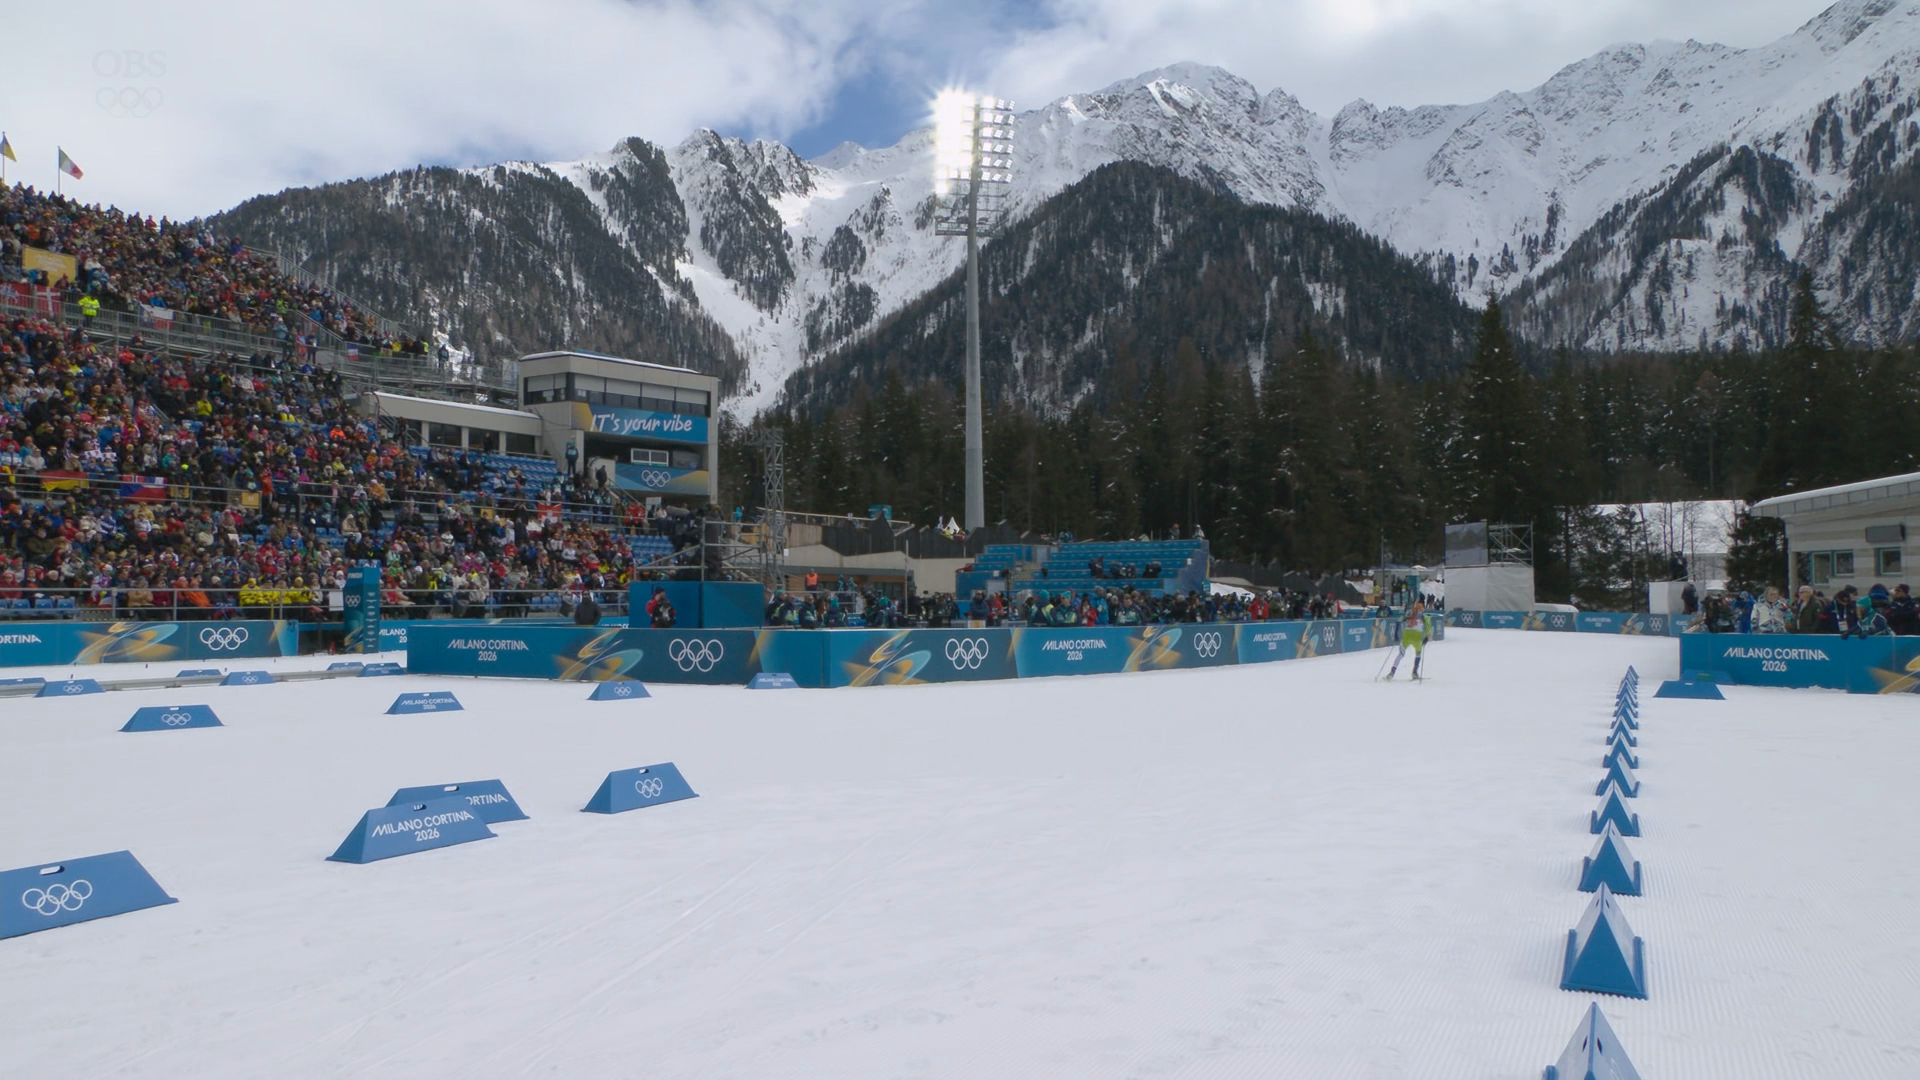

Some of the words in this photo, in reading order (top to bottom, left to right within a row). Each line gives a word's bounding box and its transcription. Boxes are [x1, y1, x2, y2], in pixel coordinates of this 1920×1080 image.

[589, 413, 620, 433] IT's
[620, 418, 661, 435] your
[663, 414, 693, 432] vibe
[447, 639, 487, 650] MILANO
[488, 639, 530, 651] CORTINA
[1042, 640, 1075, 651] MILANO
[1075, 639, 1107, 650] CORTINA
[478, 651, 498, 661] 2026
[1066, 650, 1083, 661] 2026
[1723, 647, 1772, 659] MILANO
[1773, 648, 1830, 661] CORTINA
[1761, 660, 1787, 672] 2026
[371, 818, 423, 838] MILANO
[424, 810, 475, 828] CORTINA
[414, 828, 440, 842] 2026
